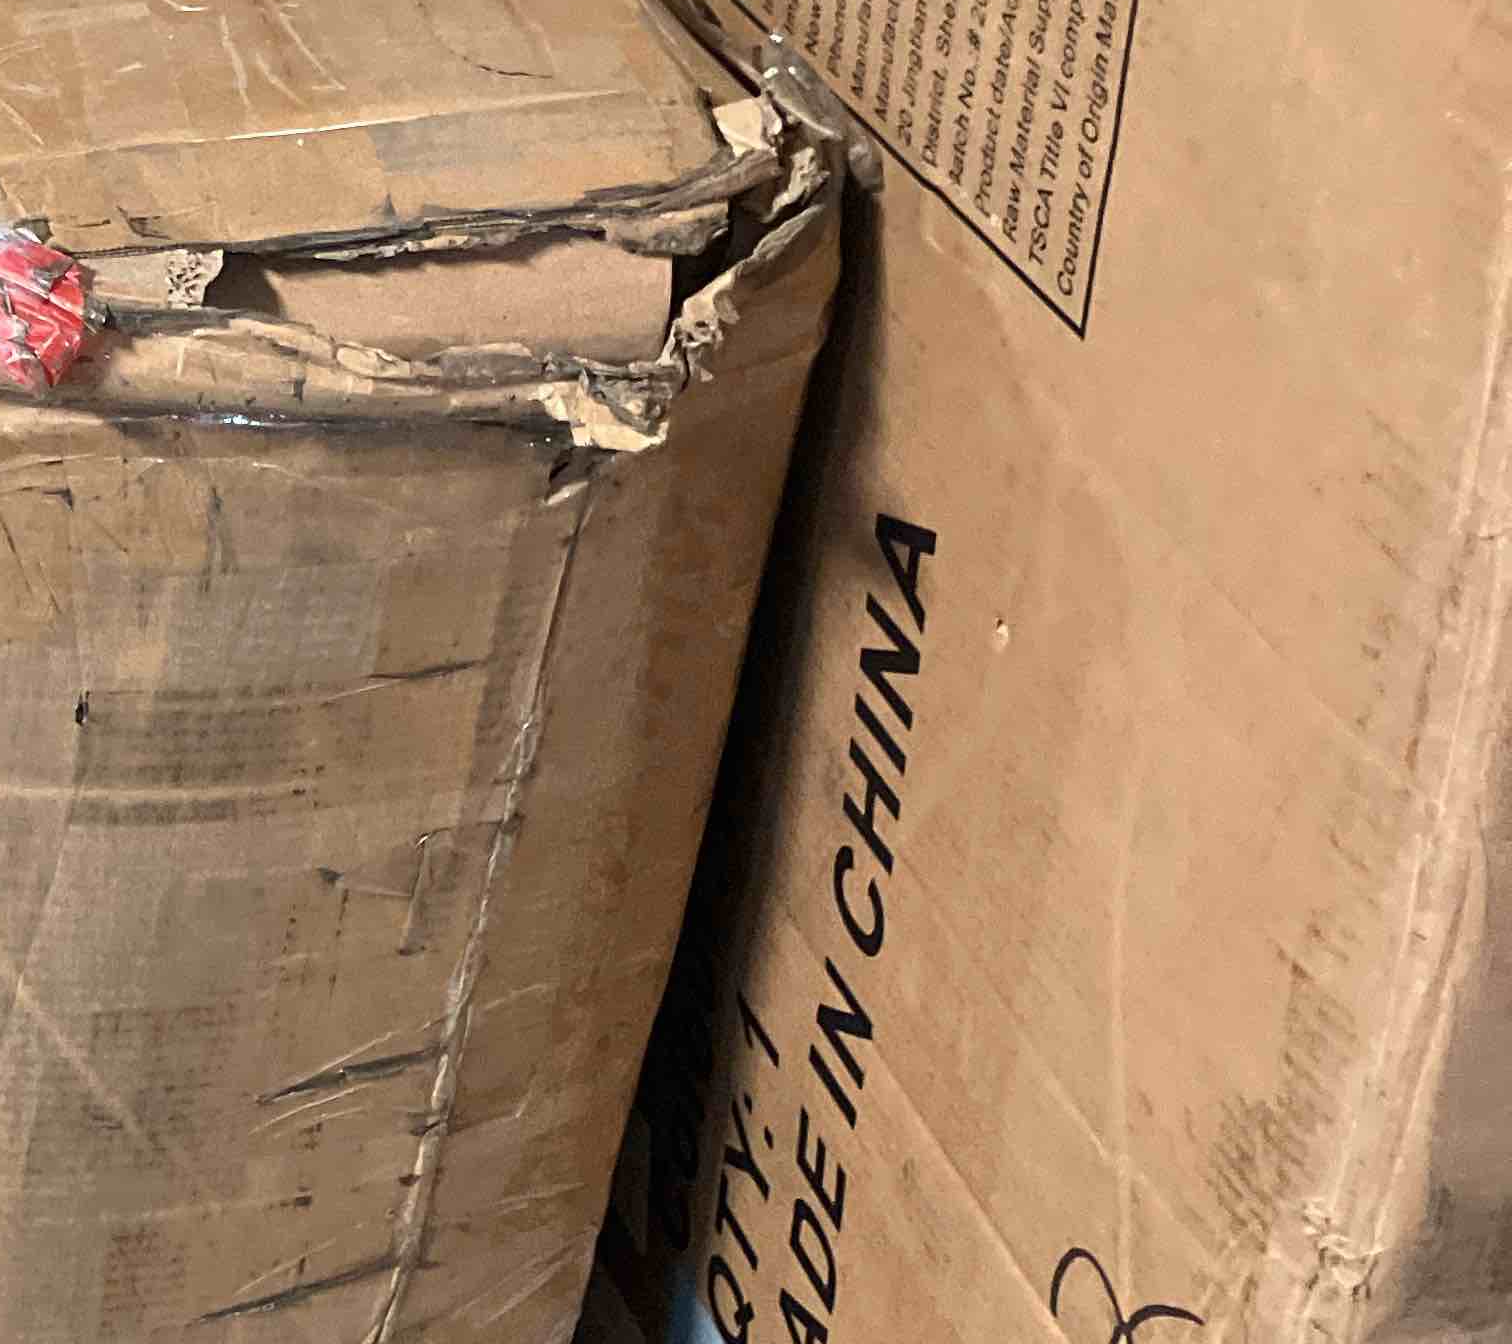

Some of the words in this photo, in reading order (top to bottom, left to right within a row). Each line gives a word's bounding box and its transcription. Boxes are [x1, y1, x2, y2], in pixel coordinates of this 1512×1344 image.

[1008, 55, 1040, 178] Material
[1050, 79, 1070, 112] VI
[1080, 52, 1108, 144] Origin
[973, 107, 1000, 218] Product
[1039, 120, 1063, 180] Title
[1077, 143, 1093, 179] of
[1002, 181, 1020, 244] Raw
[1028, 188, 1052, 265] TSCA
[1056, 181, 1090, 296] Country
[834, 514, 936, 957] CHINA
[739, 994, 782, 1067] 1
[813, 957, 873, 1126] IN
